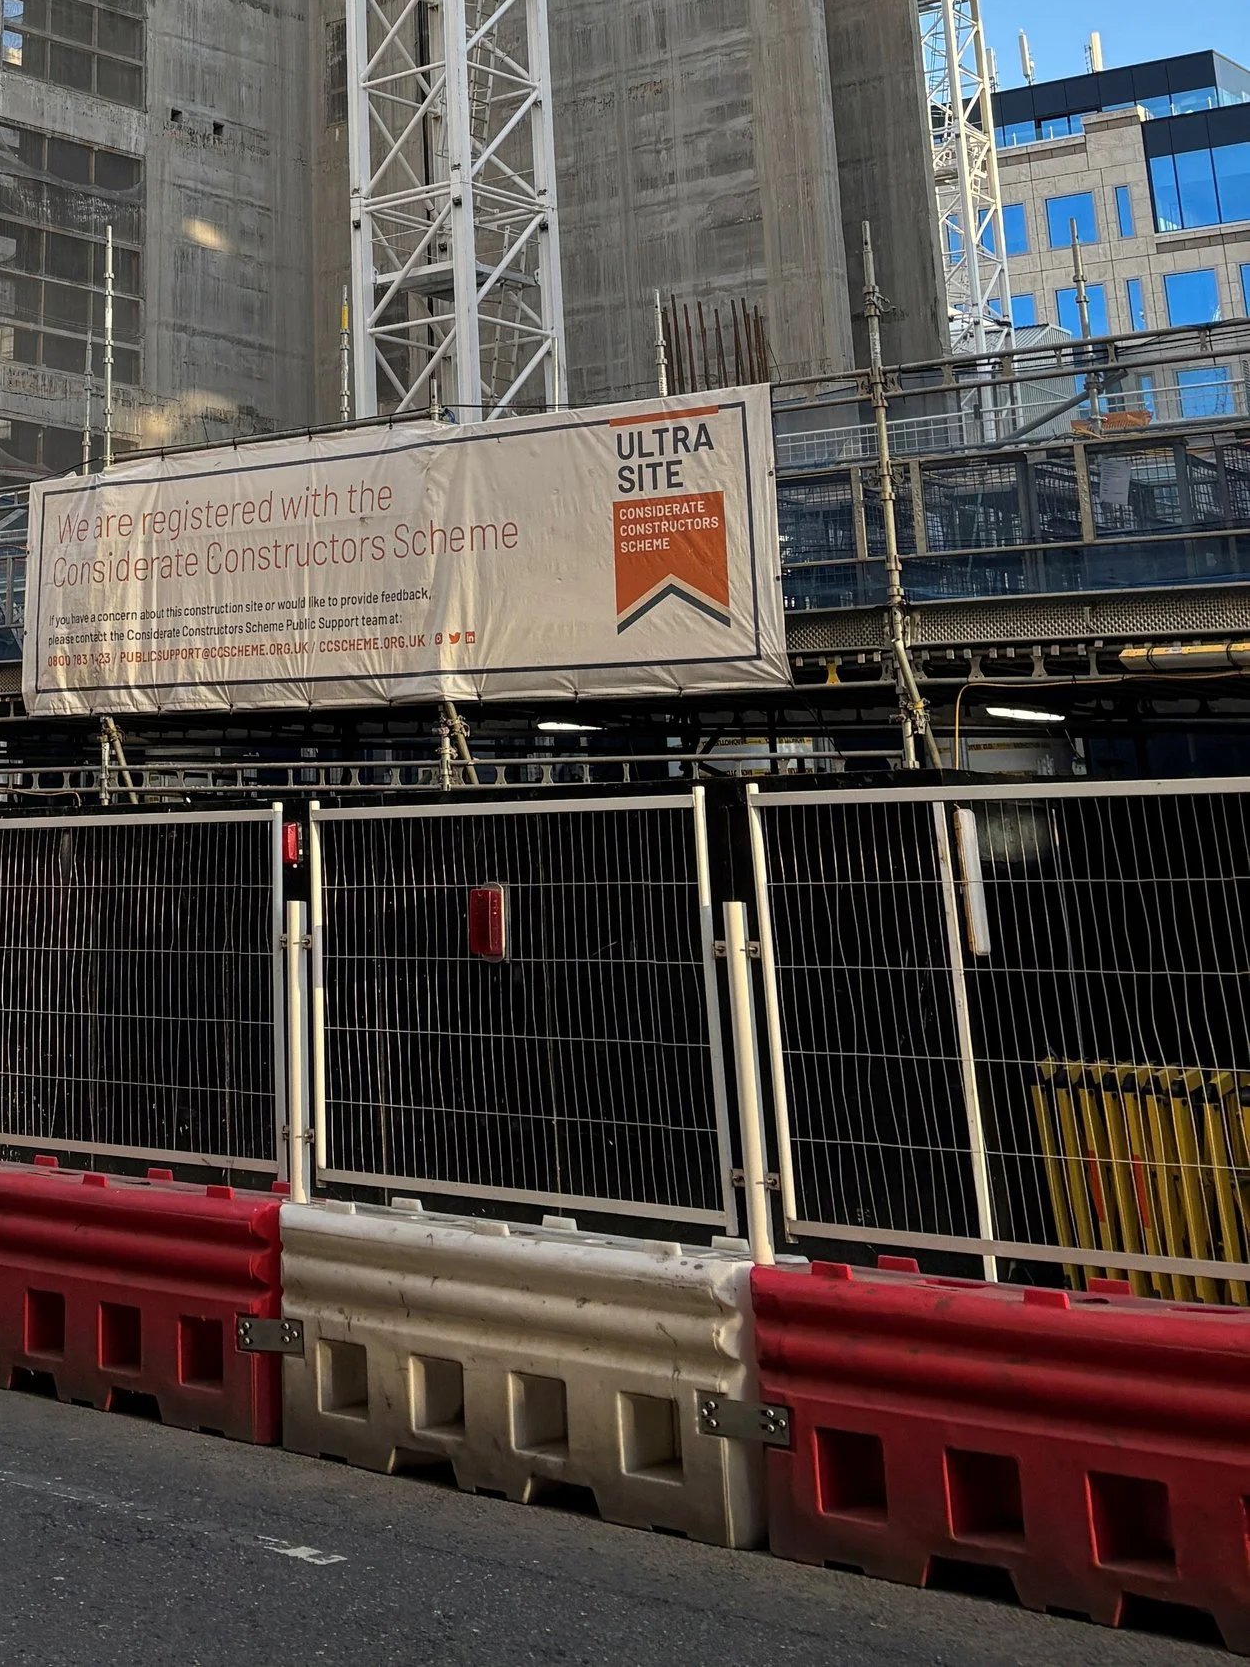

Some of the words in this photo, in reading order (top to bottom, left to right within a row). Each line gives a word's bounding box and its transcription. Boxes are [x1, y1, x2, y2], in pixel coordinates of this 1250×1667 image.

[616, 422, 714, 460] ULTRA
[618, 460, 684, 494] SITE
[58, 512, 89, 544] We
[93, 513, 133, 539] are
[142, 490, 273, 541] registered
[281, 484, 338, 521] with
[347, 480, 392, 514] the
[619, 501, 706, 520] CONSIDERATE
[620, 516, 719, 536] CONSTRUCTORS
[53, 548, 198, 588] Considerate
[206, 534, 386, 575] Constructors
[394, 520, 518, 558] Scheme
[620, 538, 670, 554] SCHEME
[49, 615, 54, 626] If
[55, 615, 70, 628] you
[70, 613, 89, 624] have
[90, 614, 96, 623] a
[98, 611, 138, 622] concern
[140, 609, 164, 620] about
[166, 606, 182, 618] this
[184, 602, 243, 616] construction
[246, 600, 263, 612] site
[265, 601, 276, 611] or
[278, 597, 306, 610] would
[308, 596, 326, 608] like
[328, 596, 338, 606] to
[340, 592, 378, 609] provide
[381, 587, 432, 602] feedback,
[48, 635, 74, 647] please
[76, 631, 108, 644] contact
[110, 630, 124, 641] the
[127, 627, 180, 641] Considerate
[182, 624, 244, 637] Constructors
[246, 621, 284, 634] Scheme
[286, 617, 316, 631] Public
[318, 616, 358, 631] Support
[362, 616, 388, 626] team
[390, 613, 402, 624] at:
[48, 654, 70, 667] 0800
[74, 654, 88, 666] 783
[120, 642, 309, 663] PUBLICSUPPORT@CCSCHEME.ORG.UK
[320, 634, 426, 652] CCSCHEME.ORG.UK
